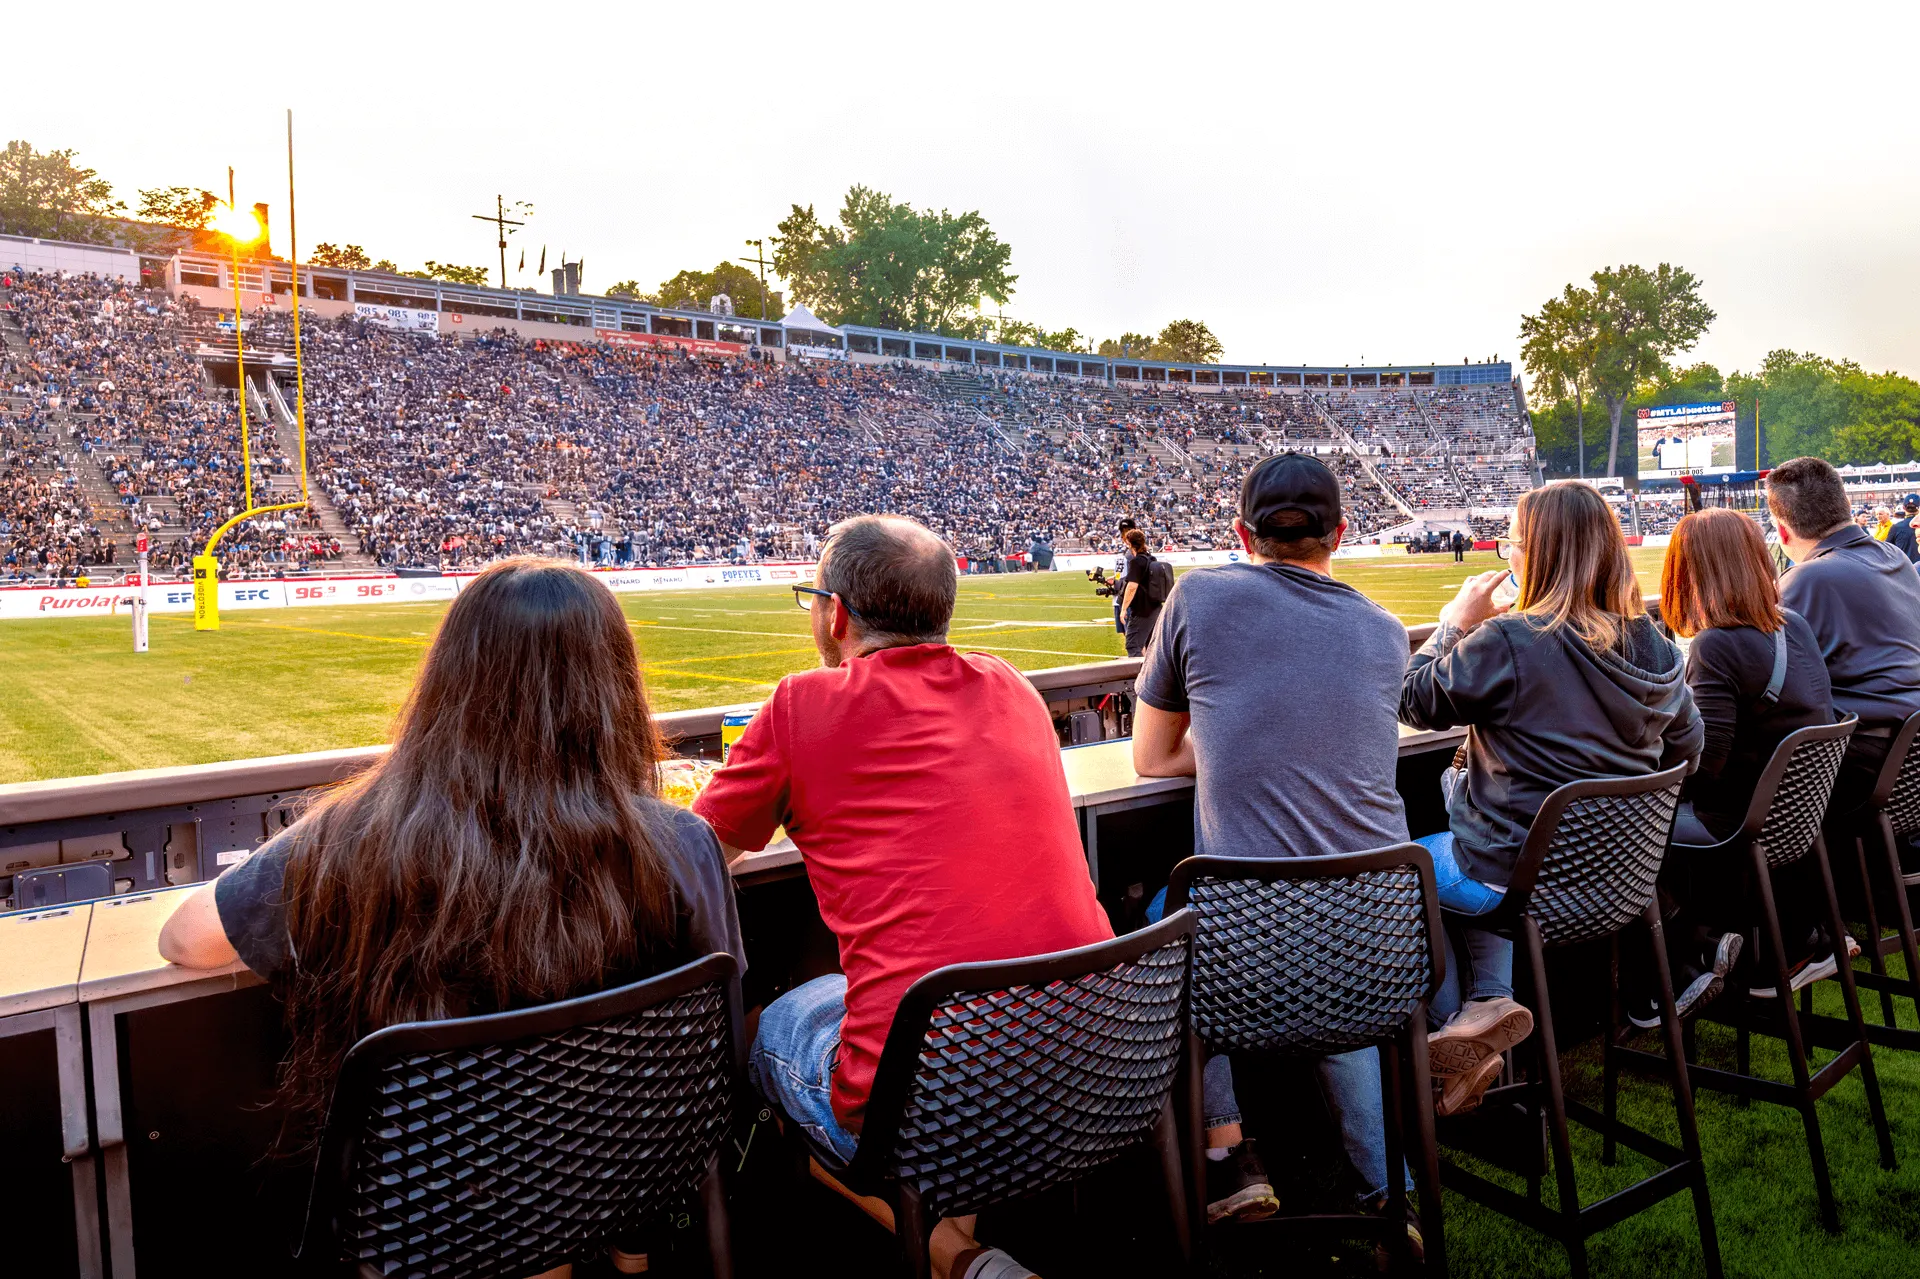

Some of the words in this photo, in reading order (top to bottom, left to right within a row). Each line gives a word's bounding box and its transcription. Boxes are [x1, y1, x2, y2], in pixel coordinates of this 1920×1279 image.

[1650, 405, 1722, 417] #MTLAlouettes
[167, 592, 196, 604] EF
[235, 589, 270, 601] EFC
[39, 595, 141, 611] Purolat
